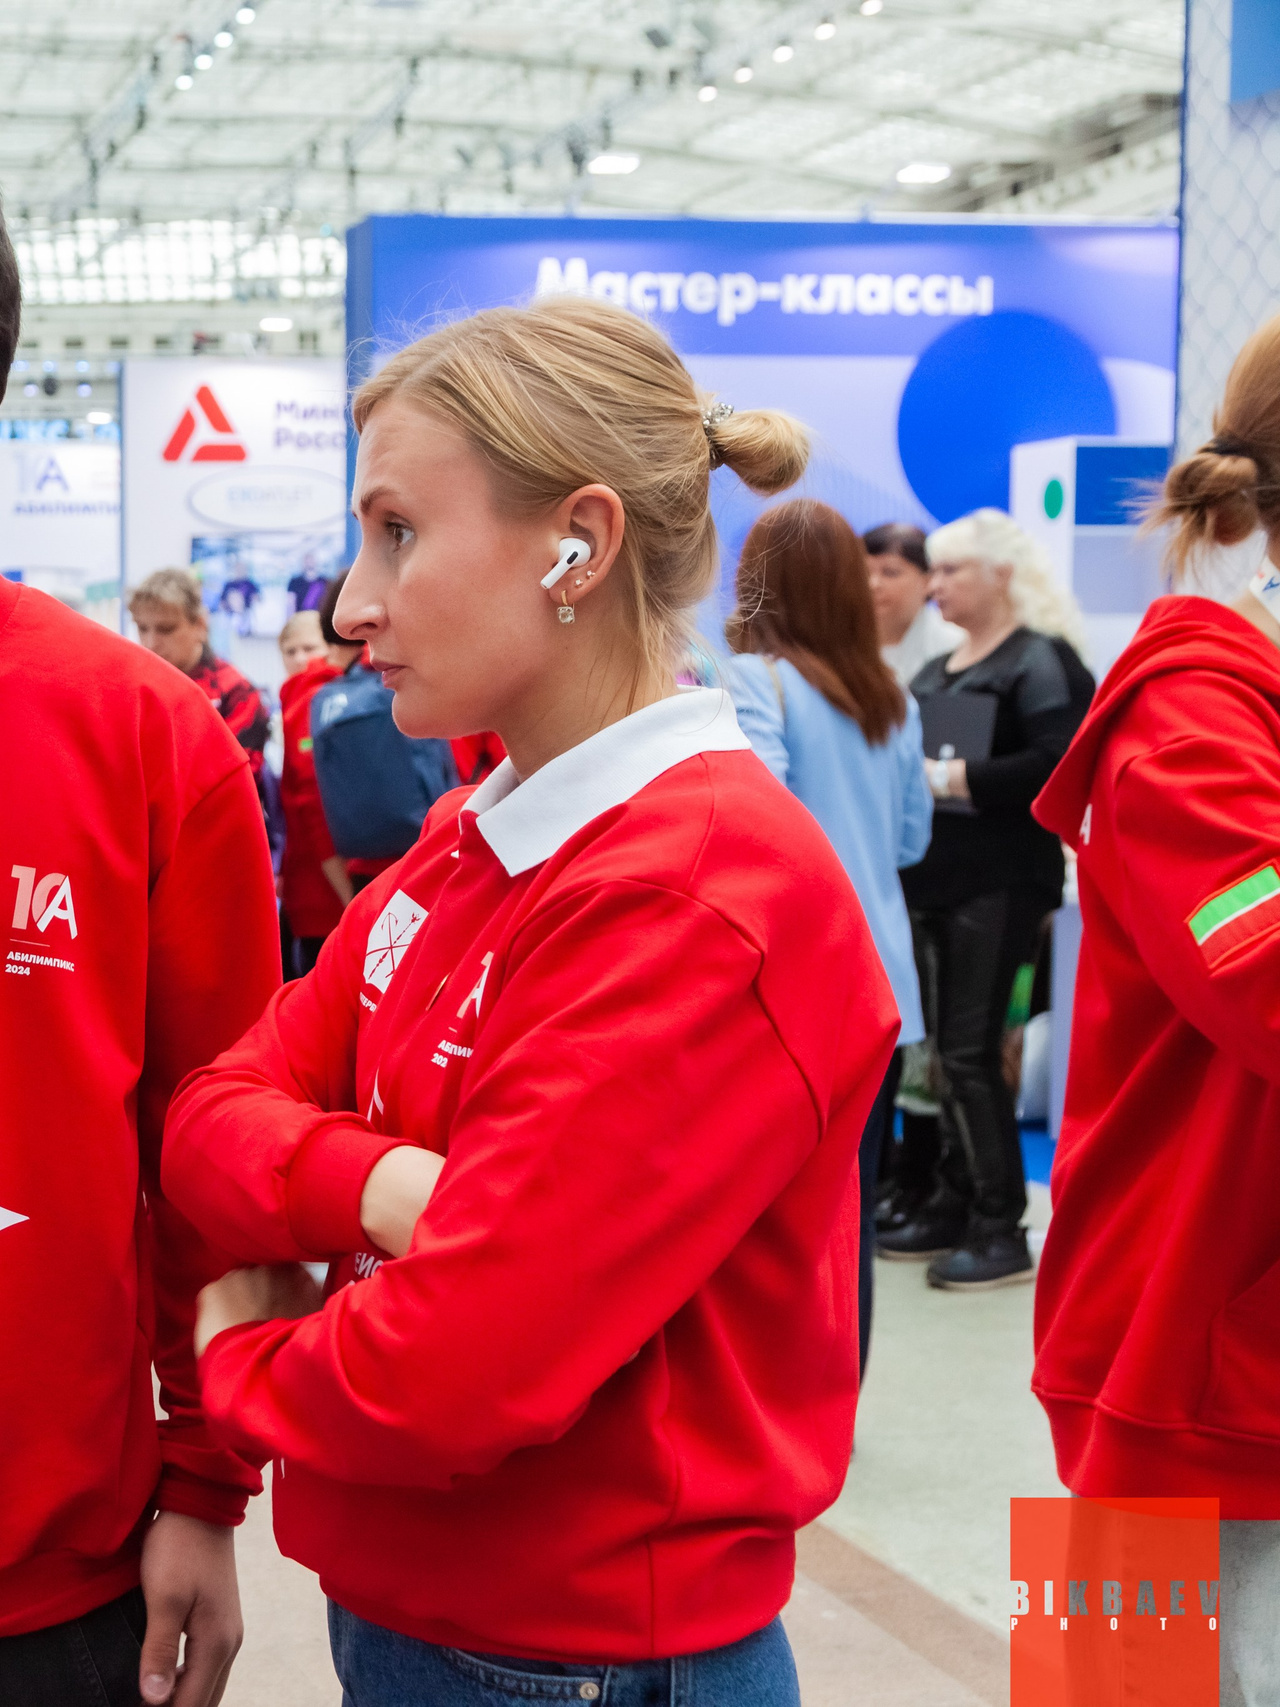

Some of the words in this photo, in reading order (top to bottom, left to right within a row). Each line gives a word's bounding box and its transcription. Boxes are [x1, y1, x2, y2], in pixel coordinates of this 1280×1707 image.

[536, 256, 995, 327] Мастер-классы
[5, 963, 31, 976] 2024
[6, 950, 75, 972] АБИЛИМПИКС
[431, 1053, 449, 1068] 202
